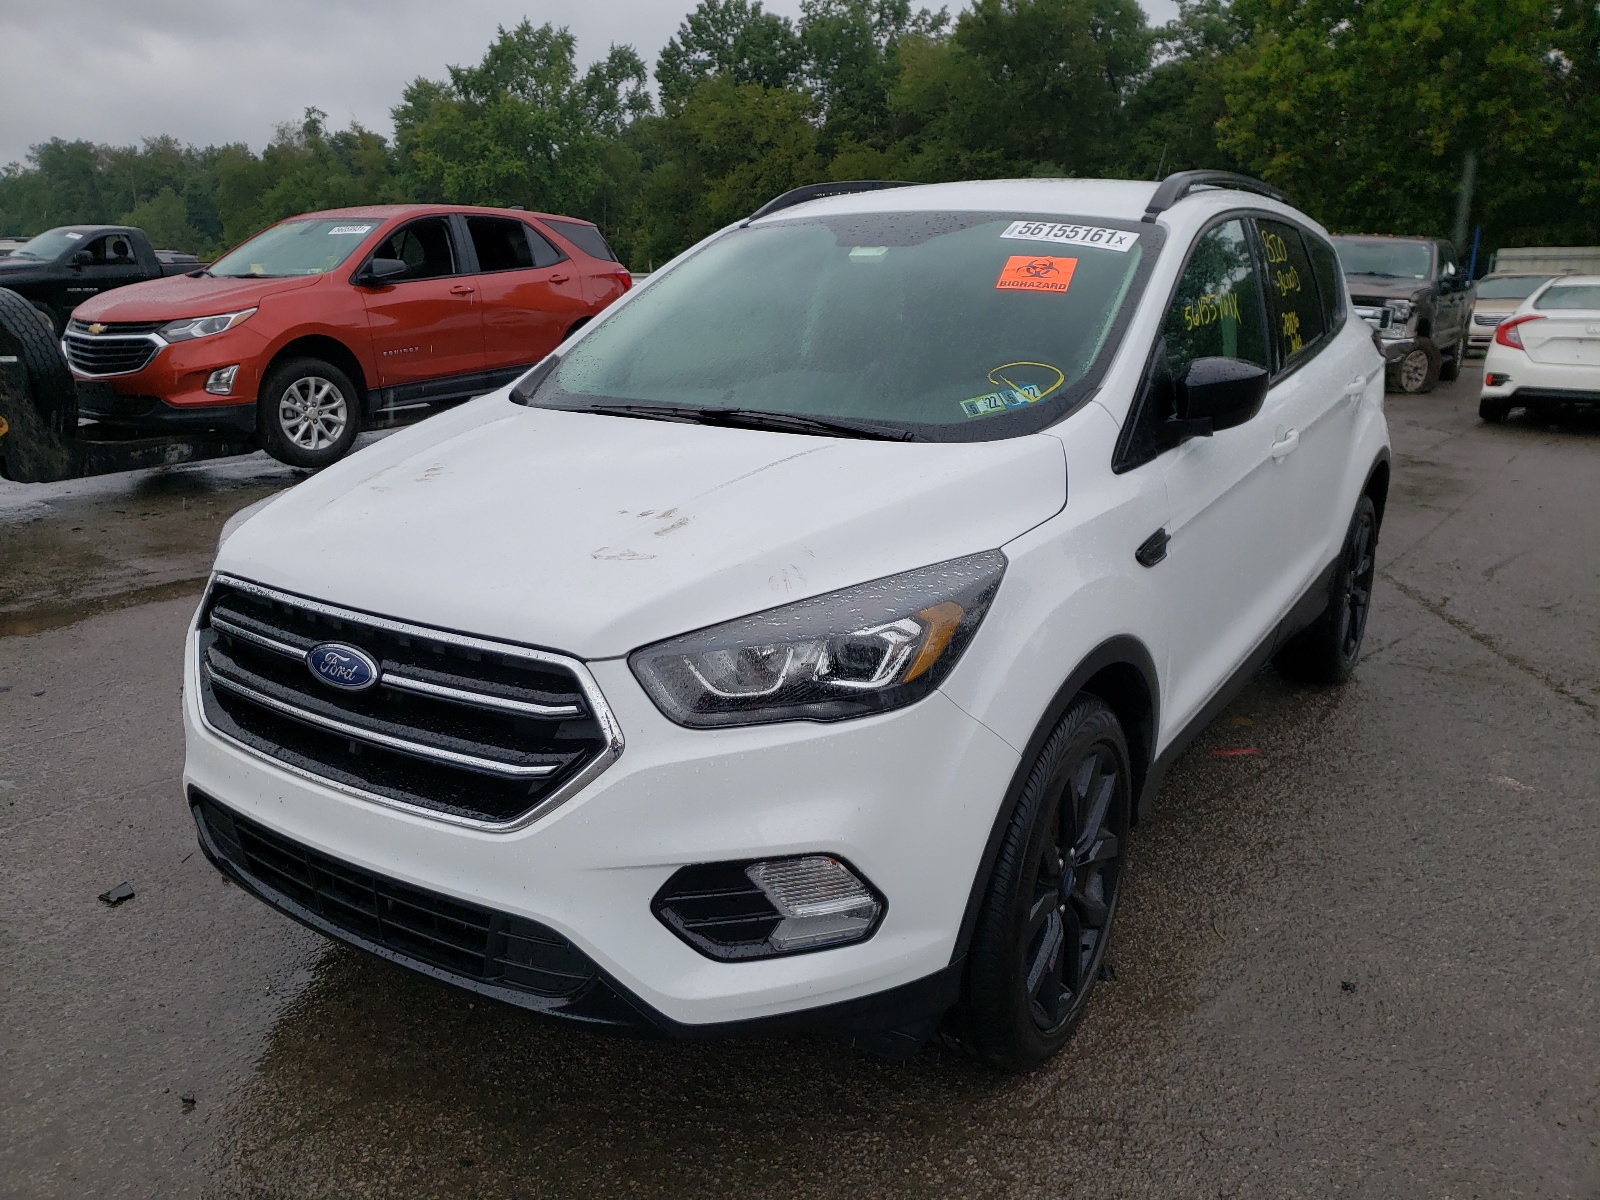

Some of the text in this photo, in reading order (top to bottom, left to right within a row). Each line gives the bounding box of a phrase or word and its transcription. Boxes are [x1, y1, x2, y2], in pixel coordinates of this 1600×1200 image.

[1000, 280, 1067, 290] BIOHAZARD
[985, 396, 1000, 409] 22
[320, 651, 358, 681] Ford
